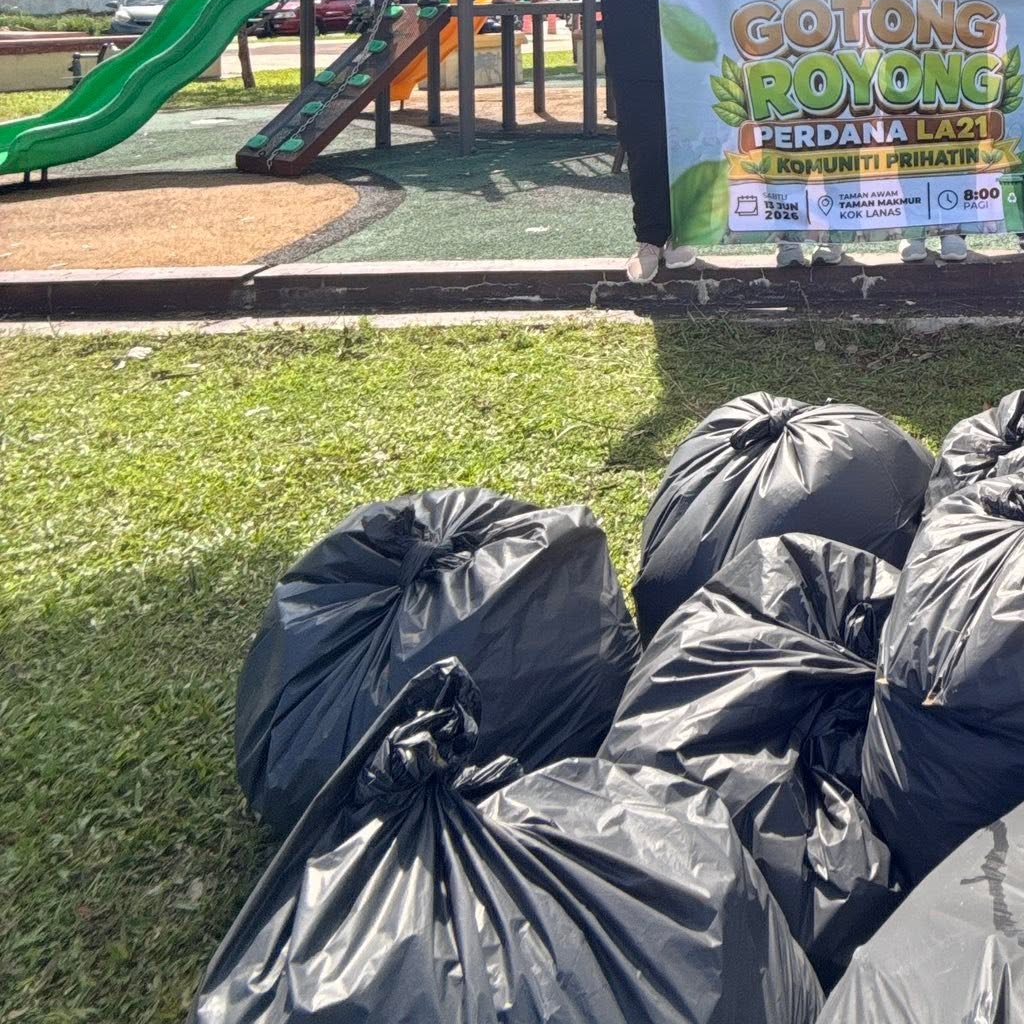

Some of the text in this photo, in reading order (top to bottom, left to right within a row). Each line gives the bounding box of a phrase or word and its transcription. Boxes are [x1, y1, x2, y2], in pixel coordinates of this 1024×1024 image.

[745, 51, 1002, 120] ROYONG
[754, 117, 988, 148] PERDANA LA21
[776, 147, 979, 175] KOMUNITI PRIHATIN
[840, 190, 898, 200] TAMAN AWAM
[963, 187, 1000, 201] 8:00
[764, 201, 799, 211] 13 JUN
[839, 197, 922, 209] TAMAN MAKMUR
[964, 201, 988, 210] PAGI
[765, 210, 799, 220] 2026
[840, 208, 902, 219] KOK LANAS
